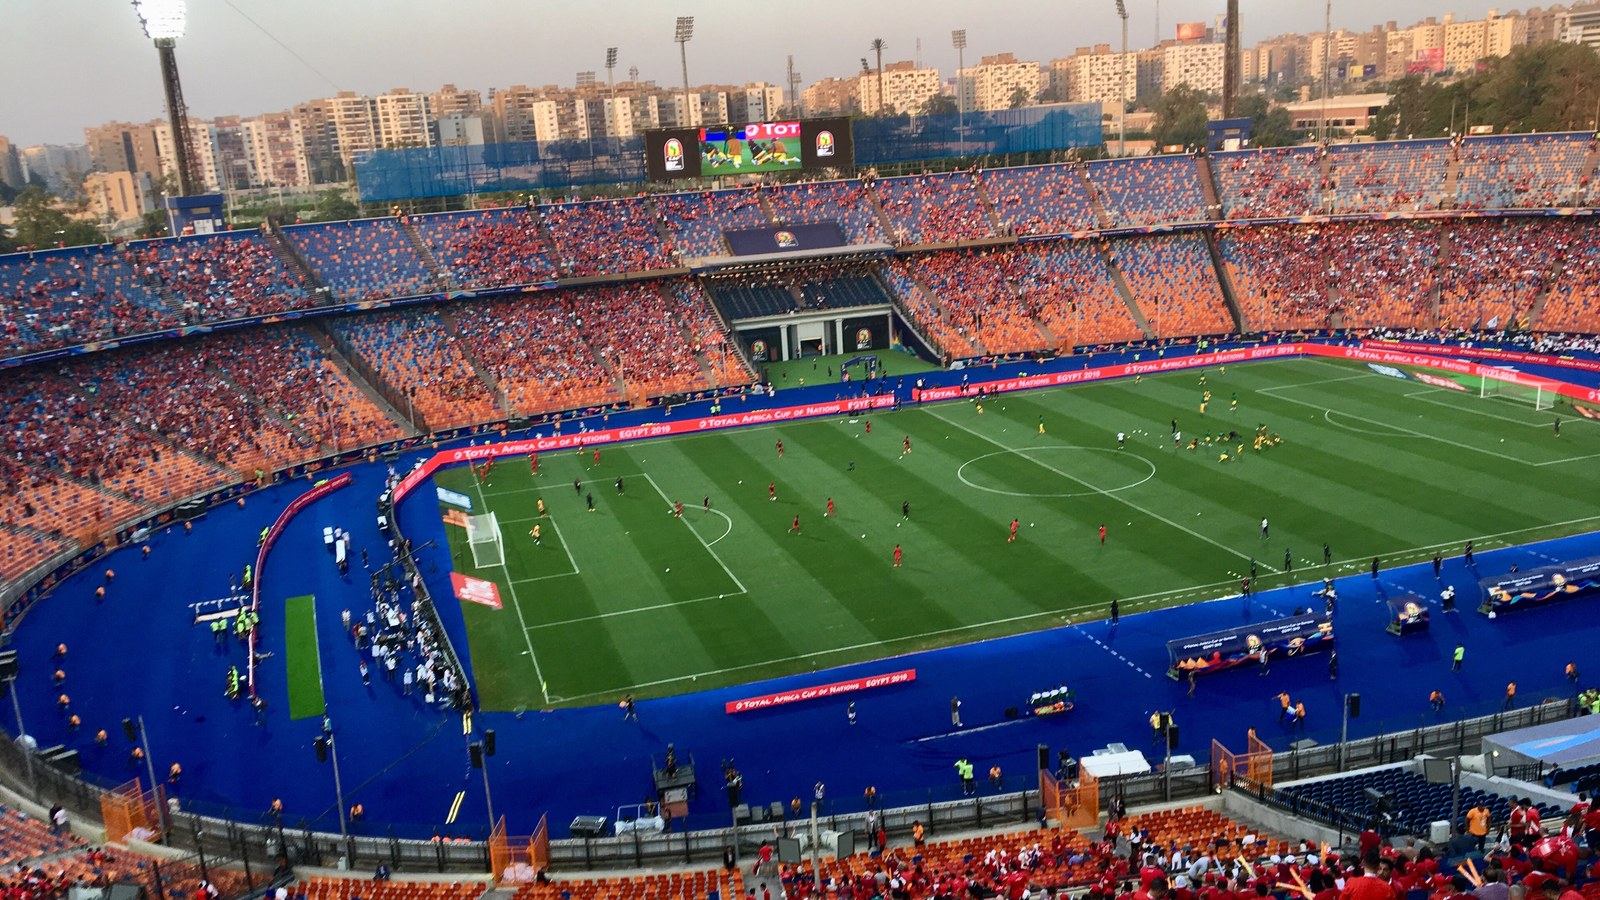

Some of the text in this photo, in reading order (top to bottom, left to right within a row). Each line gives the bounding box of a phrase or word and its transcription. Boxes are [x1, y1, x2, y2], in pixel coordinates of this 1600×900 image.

[762, 124, 800, 135] TOT
[1132, 364, 1158, 372] TOTAL
[1159, 360, 1187, 369] AFRICA
[1188, 356, 1204, 364] CUP
[1216, 352, 1245, 362] NATIONS
[1251, 348, 1275, 357] EGYPT
[1277, 346, 1295, 354] 2019
[1353, 349, 1381, 360] TOTAL
[1383, 353, 1412, 363] AFRICA
[1414, 356, 1430, 365] CUP
[1441, 360, 1470, 372] NATIONS
[928, 390, 957, 400] TOTAL
[961, 385, 988, 396] AFRIA
[1019, 378, 1050, 388] NATIONS
[1056, 372, 1082, 382] EGYPT
[1083, 370, 1101, 379] 2019
[708, 418, 740, 427] TOTAL
[741, 414, 773, 423] AFRICA
[774, 410, 791, 419] CUP
[806, 404, 840, 414] NATIONS
[876, 397, 894, 406] 2019
[462, 425, 671, 458] TOTAL AFRICA CUP OF NATIONS EGYPT 2019
[743, 674, 908, 708] TOTAL AFRICA CUP OF NATIONS EGYPT 2019
